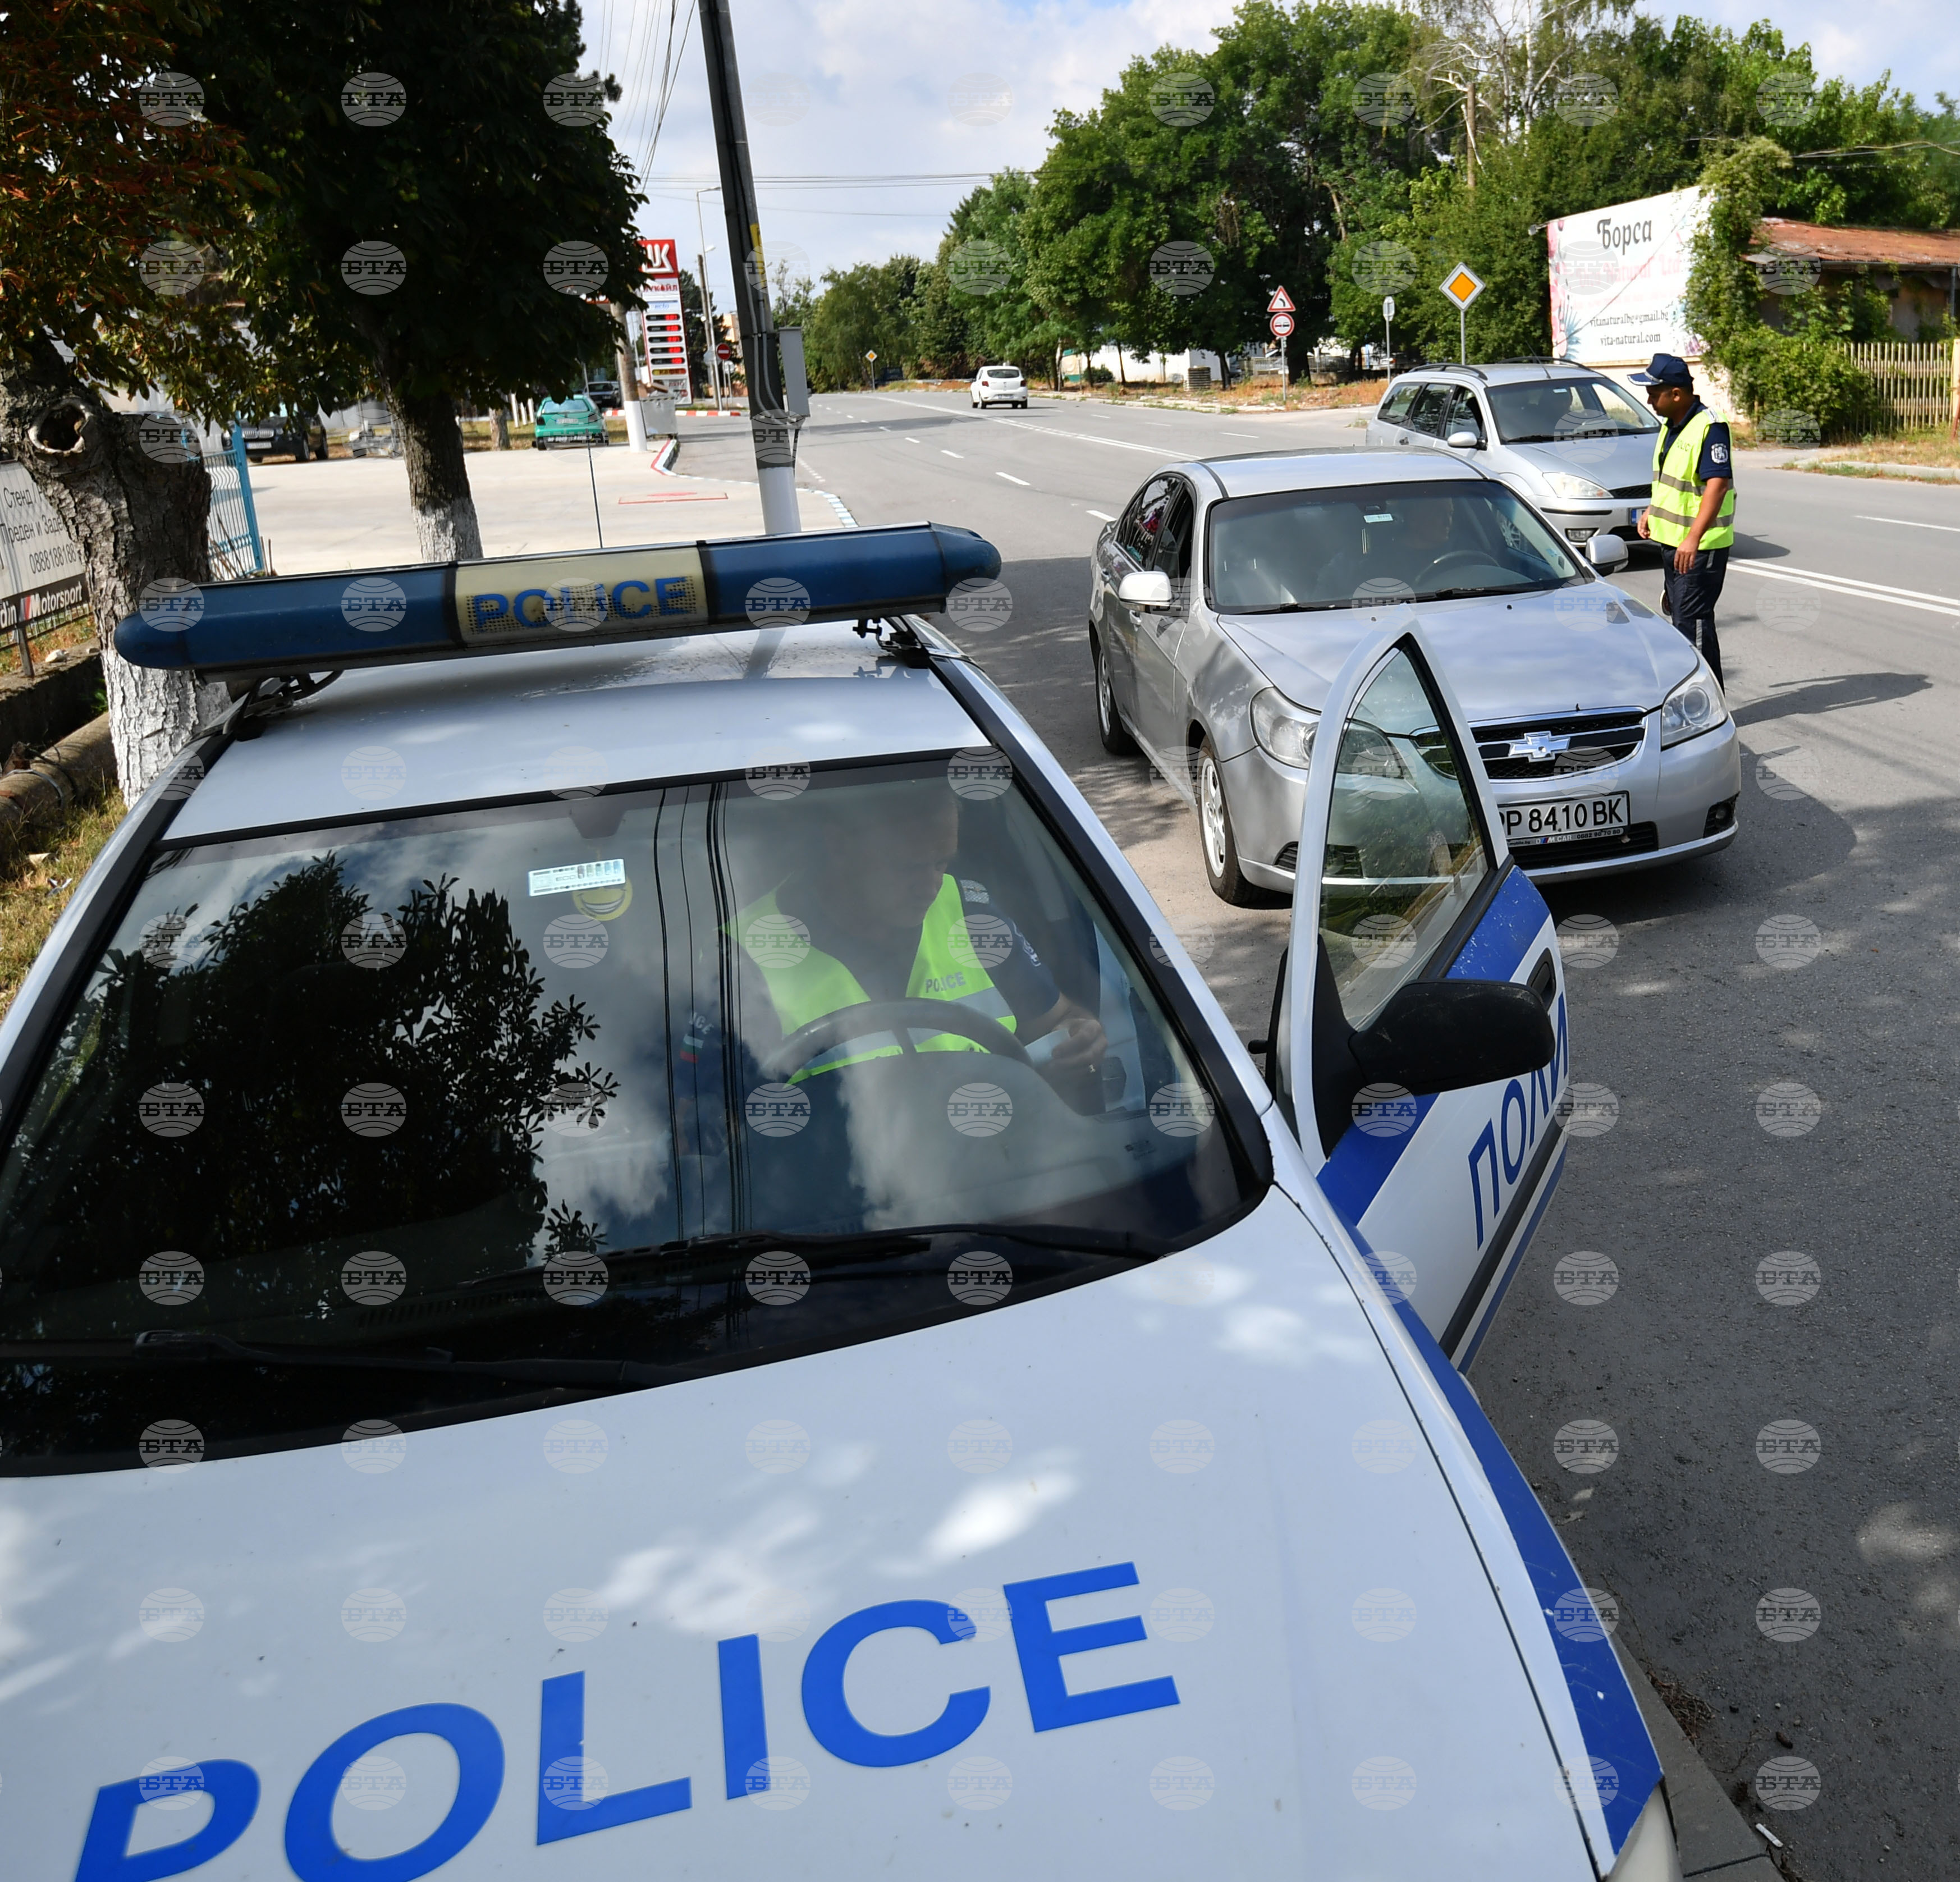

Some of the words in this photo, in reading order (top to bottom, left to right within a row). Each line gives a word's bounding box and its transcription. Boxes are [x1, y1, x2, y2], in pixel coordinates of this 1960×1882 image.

[1597, 218, 1652, 255] Борса
[1600, 332, 1661, 346] vita-natural.com
[3, 487, 33, 508] Стенд
[0, 521, 35, 548] Преден
[42, 514, 66, 534] Заде
[29, 543, 77, 574] 0888188188
[30, 580, 83, 619] Motorsport
[471, 576, 689, 633] POLICE
[1528, 803, 1587, 833] 8410
[1593, 798, 1623, 826] BK
[73, 1562, 1180, 1882] POLICE
